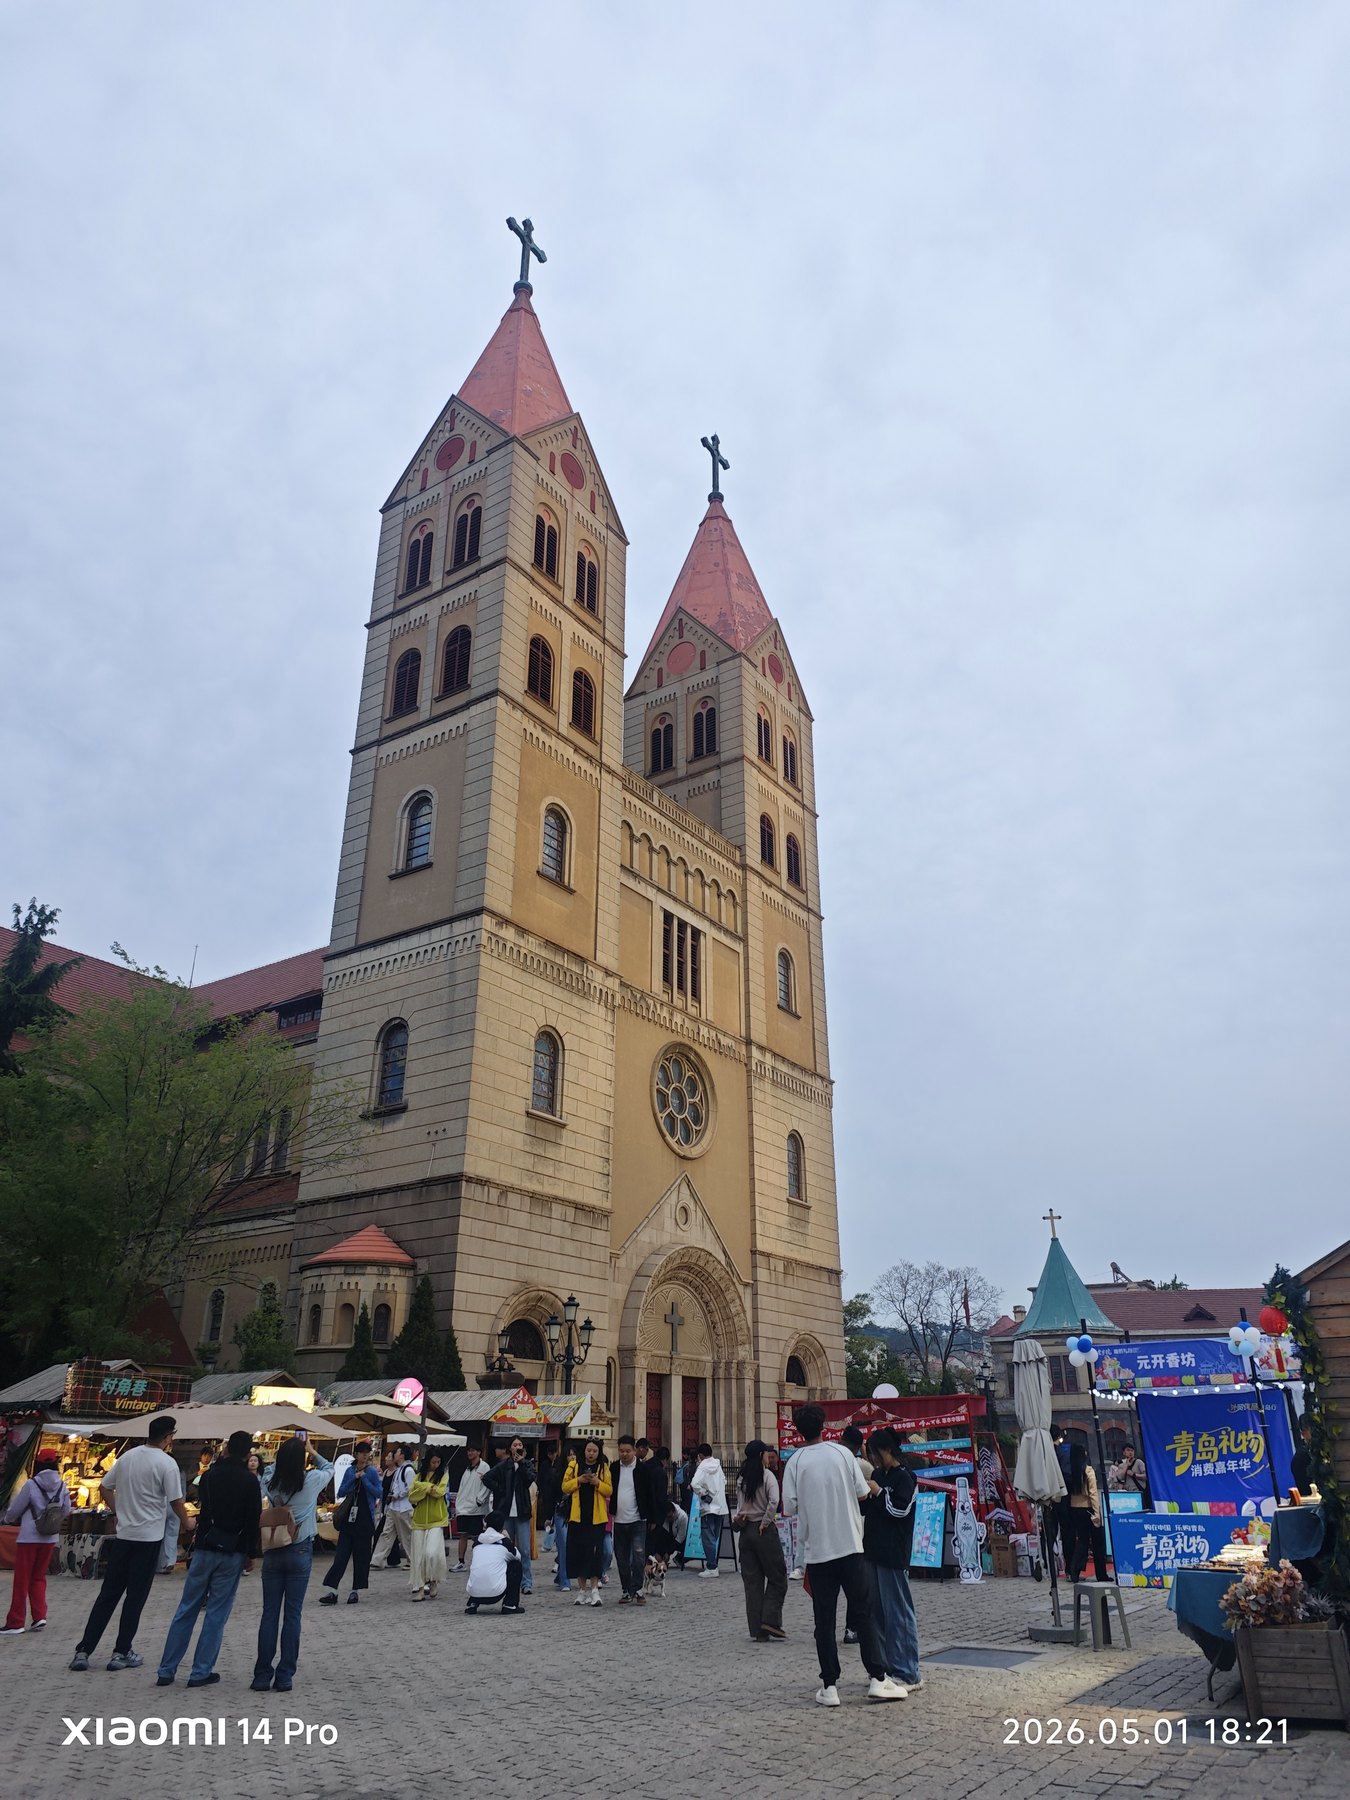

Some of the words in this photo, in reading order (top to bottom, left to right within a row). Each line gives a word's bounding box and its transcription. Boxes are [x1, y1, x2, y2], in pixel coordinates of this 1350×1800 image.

[1136, 1352, 1196, 1371] 元开香坊
[100, 1377, 148, 1397] 对角巷
[114, 1397, 157, 1413] Vintage
[934, 1450, 970, 1464] Laoshan
[1165, 1429, 1265, 1477] 青岛礼物
[1191, 1457, 1252, 1478] 消费嘉年华
[1135, 1533, 1210, 1570] 青岛礼物
[1155, 1557, 1201, 1570] 消费嘉年华
